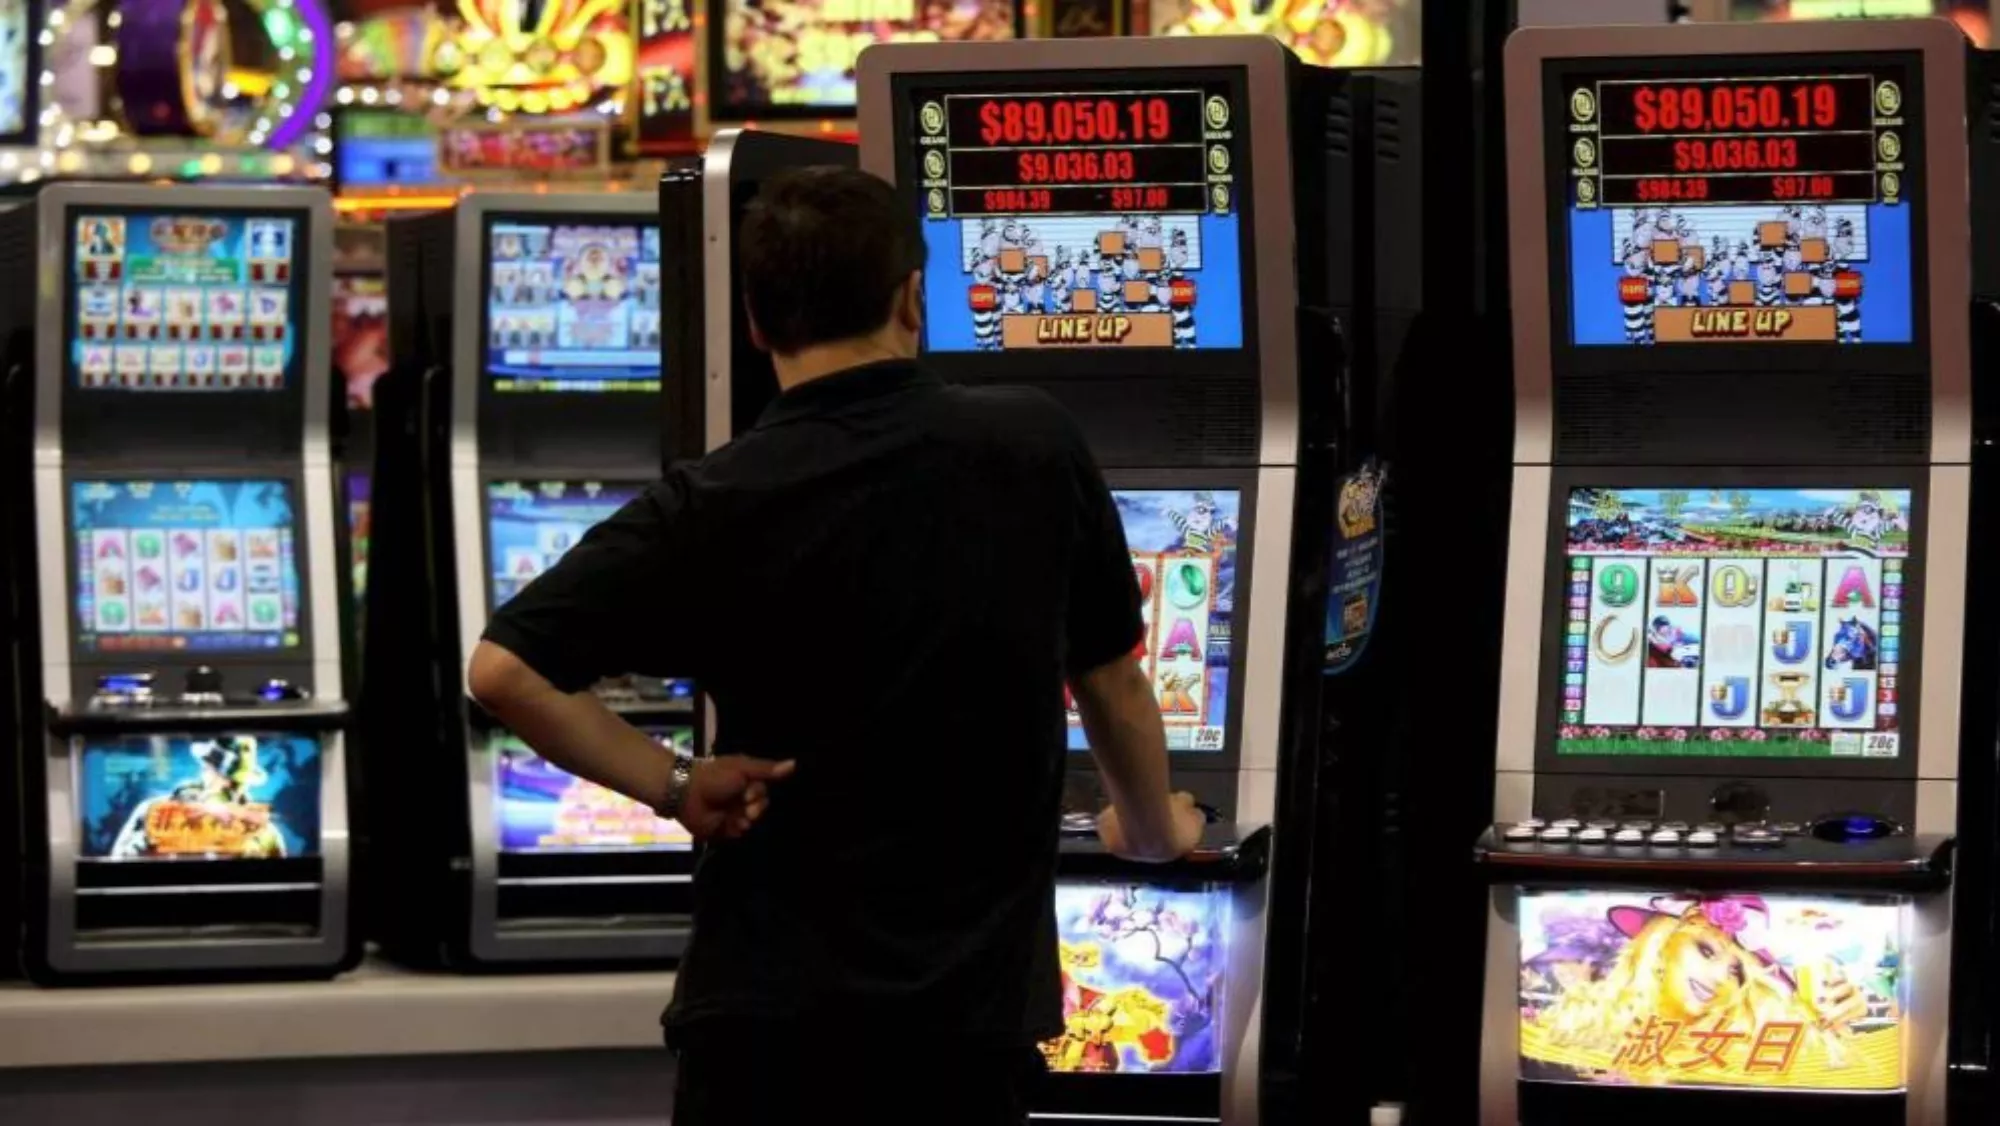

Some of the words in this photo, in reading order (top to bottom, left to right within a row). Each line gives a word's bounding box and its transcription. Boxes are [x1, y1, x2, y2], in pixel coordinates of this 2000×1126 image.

[980, 98, 1171, 145] $89,050.19
[1634, 83, 1836, 134] $89,050.19
[1019, 151, 1135, 183] $9,036.03
[1673, 138, 1798, 171] $9,036.03
[1037, 316, 1091, 343] LINE
[1096, 316, 1132, 343] UP
[1690, 309, 1750, 338] LINE
[1754, 308, 1794, 337] UP
[1831, 566, 1876, 609] A
[1159, 618, 1203, 661] A
[1772, 621, 1813, 665] J
[1709, 676, 1750, 720] J
[1828, 677, 1870, 721] J
[1612, 1013, 1804, 1072] 淑女日
